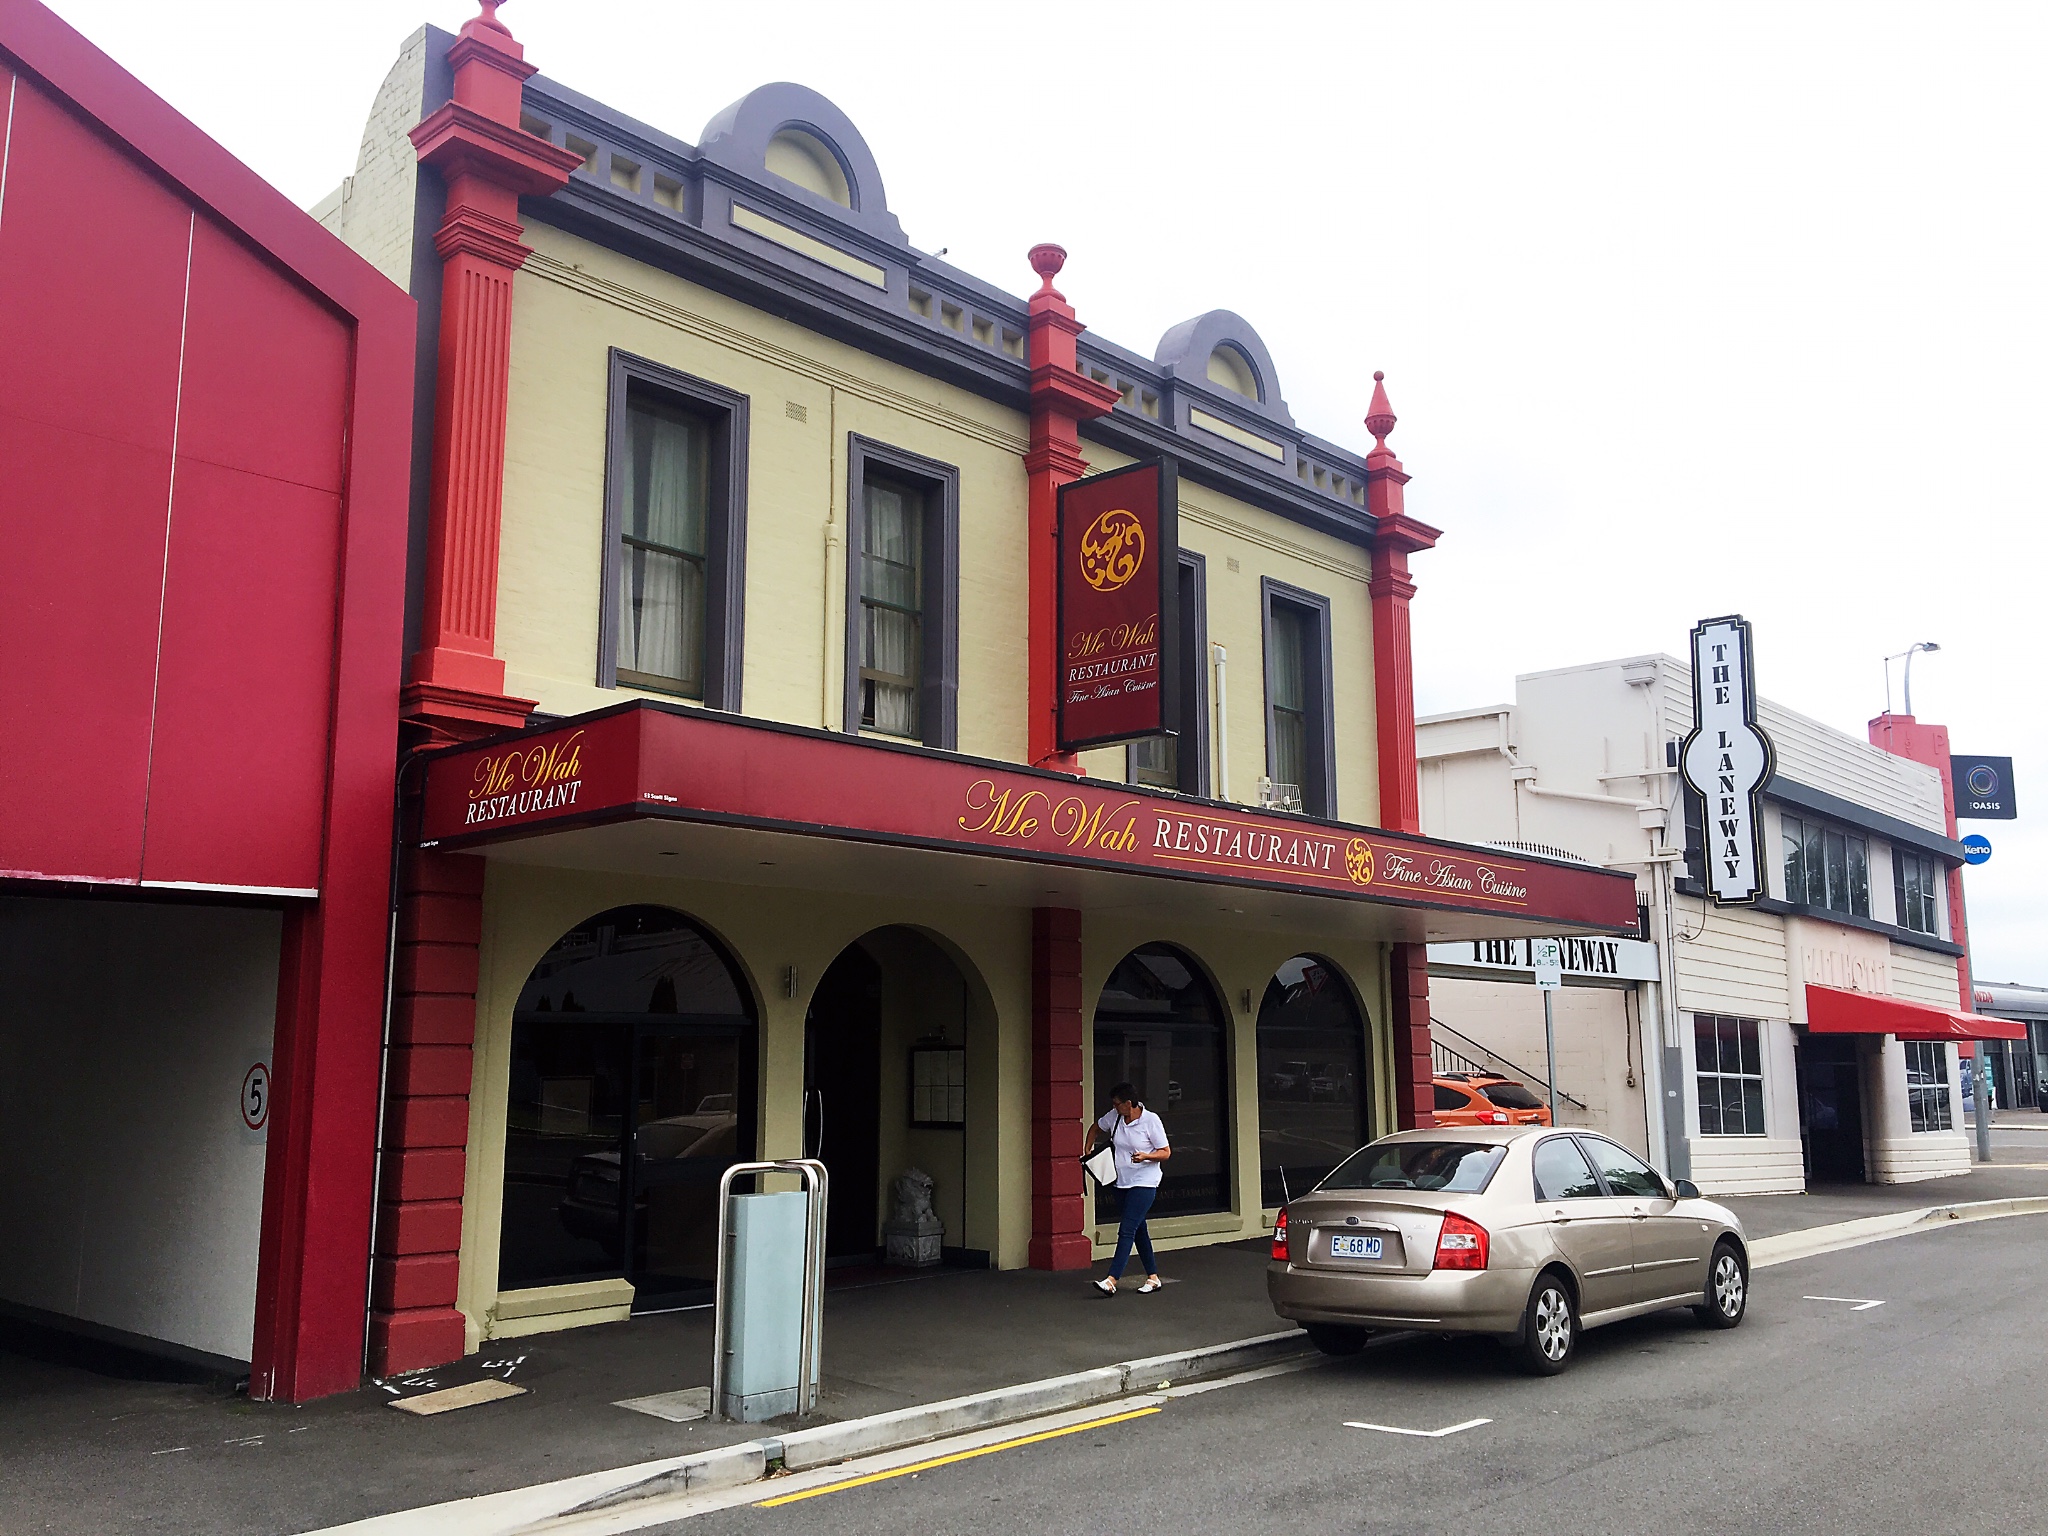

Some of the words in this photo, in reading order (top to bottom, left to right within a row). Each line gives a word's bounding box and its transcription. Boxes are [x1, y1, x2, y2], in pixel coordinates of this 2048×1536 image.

[1068, 628, 1110, 658] Me
[1111, 613, 1157, 650] Wah
[1068, 653, 1157, 682] RESTAURANT
[1712, 644, 1730, 705] THE
[1067, 690, 1089, 704] Fine
[1091, 685, 1119, 699] Asian
[1123, 679, 1156, 693] Cuisine
[468, 751, 523, 799] Me
[522, 730, 585, 787] Wah
[465, 780, 581, 824] RESTAURANT
[1718, 730, 1740, 879] LANEWAY
[1973, 802, 2000, 810] OASIS
[958, 779, 1050, 838] Me
[1051, 797, 1140, 852] Wah
[1153, 818, 1336, 870] RESTAURANT
[1383, 852, 1422, 882] Fine
[1425, 859, 1473, 891] Asian
[1477, 866, 1527, 899] Cuisine
[1965, 845, 1990, 854] keno
[1473, 939, 1517, 966] THE
[1525, 937, 1619, 973] LNEWAY
[250, 1078, 262, 1116] 5
